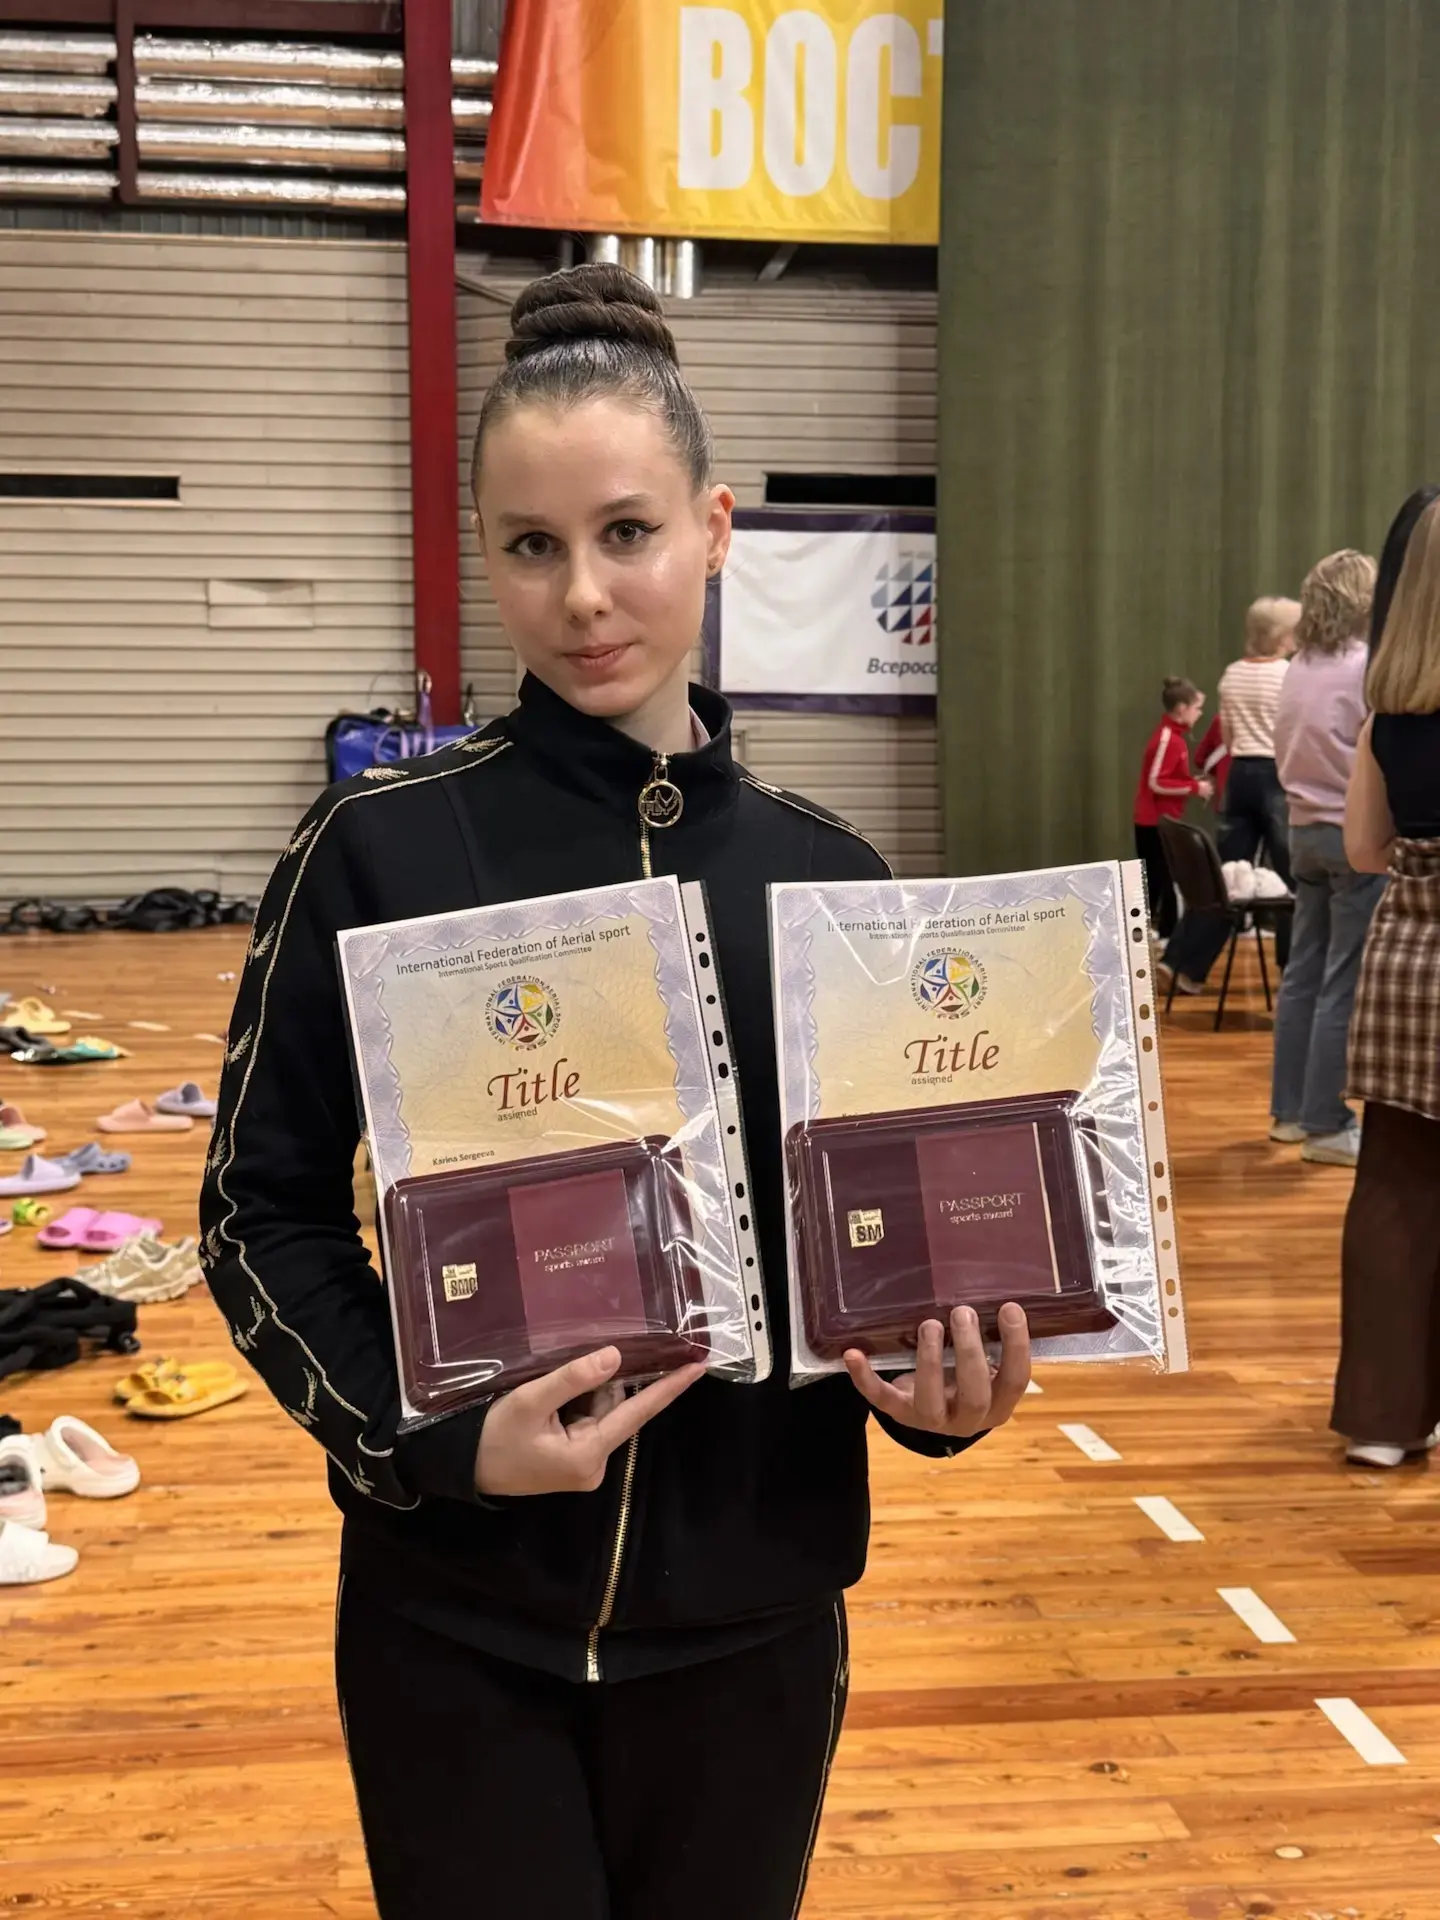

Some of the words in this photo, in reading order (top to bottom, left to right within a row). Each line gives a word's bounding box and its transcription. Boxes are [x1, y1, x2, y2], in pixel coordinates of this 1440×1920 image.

[678, 6, 943, 199] ВОС
[911, 917, 975, 930] Fderation
[979, 913, 991, 926] of
[995, 911, 1030, 925] Aerial
[1034, 907, 1066, 922] sport
[396, 951, 475, 976] International
[478, 942, 542, 961] Federation
[545, 936, 558, 950] of
[561, 930, 596, 947] Aerial
[599, 925, 631, 943] sport
[926, 947, 975, 960] FEDERATION
[438, 963, 484, 978] International
[484, 959, 508, 971] Sports
[508, 953, 553, 967] Qualification
[554, 946, 593, 958] Committee
[498, 975, 545, 988] FEDERATION
[904, 1030, 1000, 1075] Title
[487, 1057, 580, 1111] Title
[911, 1074, 953, 1086] assigned
[497, 1106, 538, 1122] assigned
[432, 1156, 458, 1166] Karina
[939, 1192, 1027, 1213] PASSPORT
[949, 1212, 982, 1225] sports
[982, 1208, 1014, 1220] award
[856, 1224, 882, 1243] SM
[534, 1237, 615, 1262] PASSPORT
